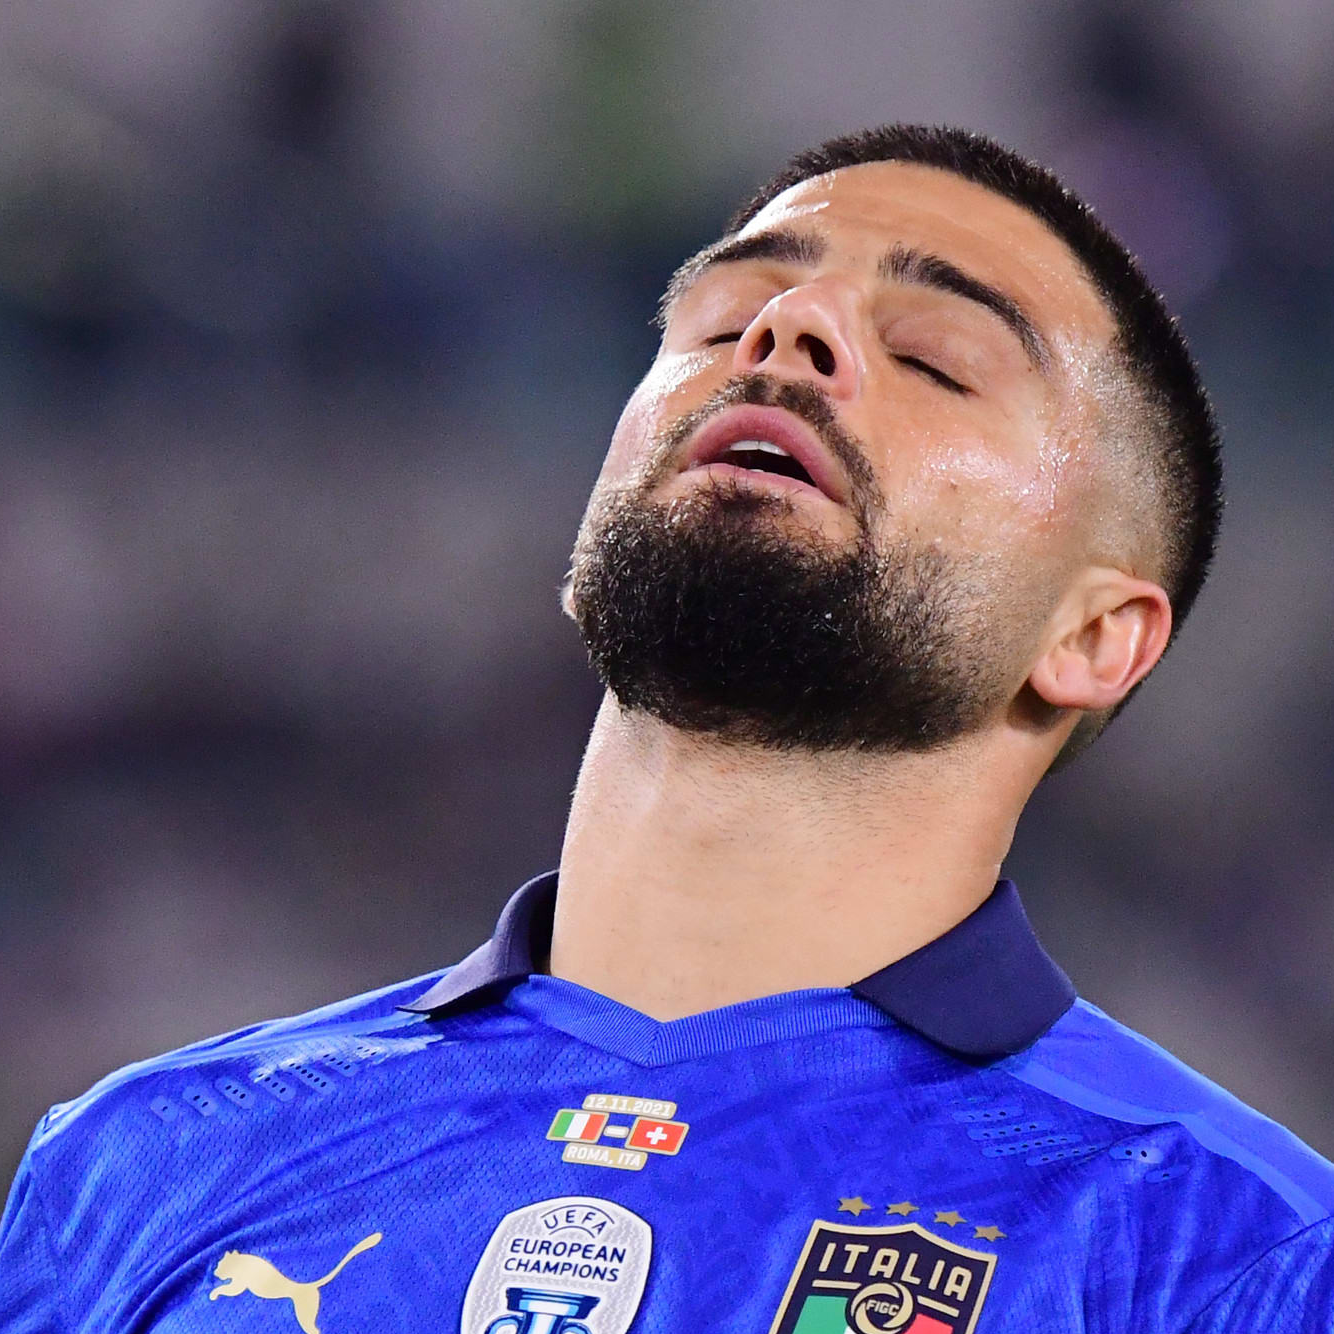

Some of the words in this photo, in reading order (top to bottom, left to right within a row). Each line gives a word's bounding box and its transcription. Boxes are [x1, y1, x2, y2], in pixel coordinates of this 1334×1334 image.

[567, 1145, 614, 1165] ROMA,
[617, 1152, 642, 1167] ITA
[544, 1209, 607, 1235] UEFA
[510, 1238, 627, 1264] EUROPEAN
[504, 1257, 620, 1282] CHAMPIONS
[818, 1242, 973, 1302] ITALIA
[866, 1299, 900, 1317] FIGC
